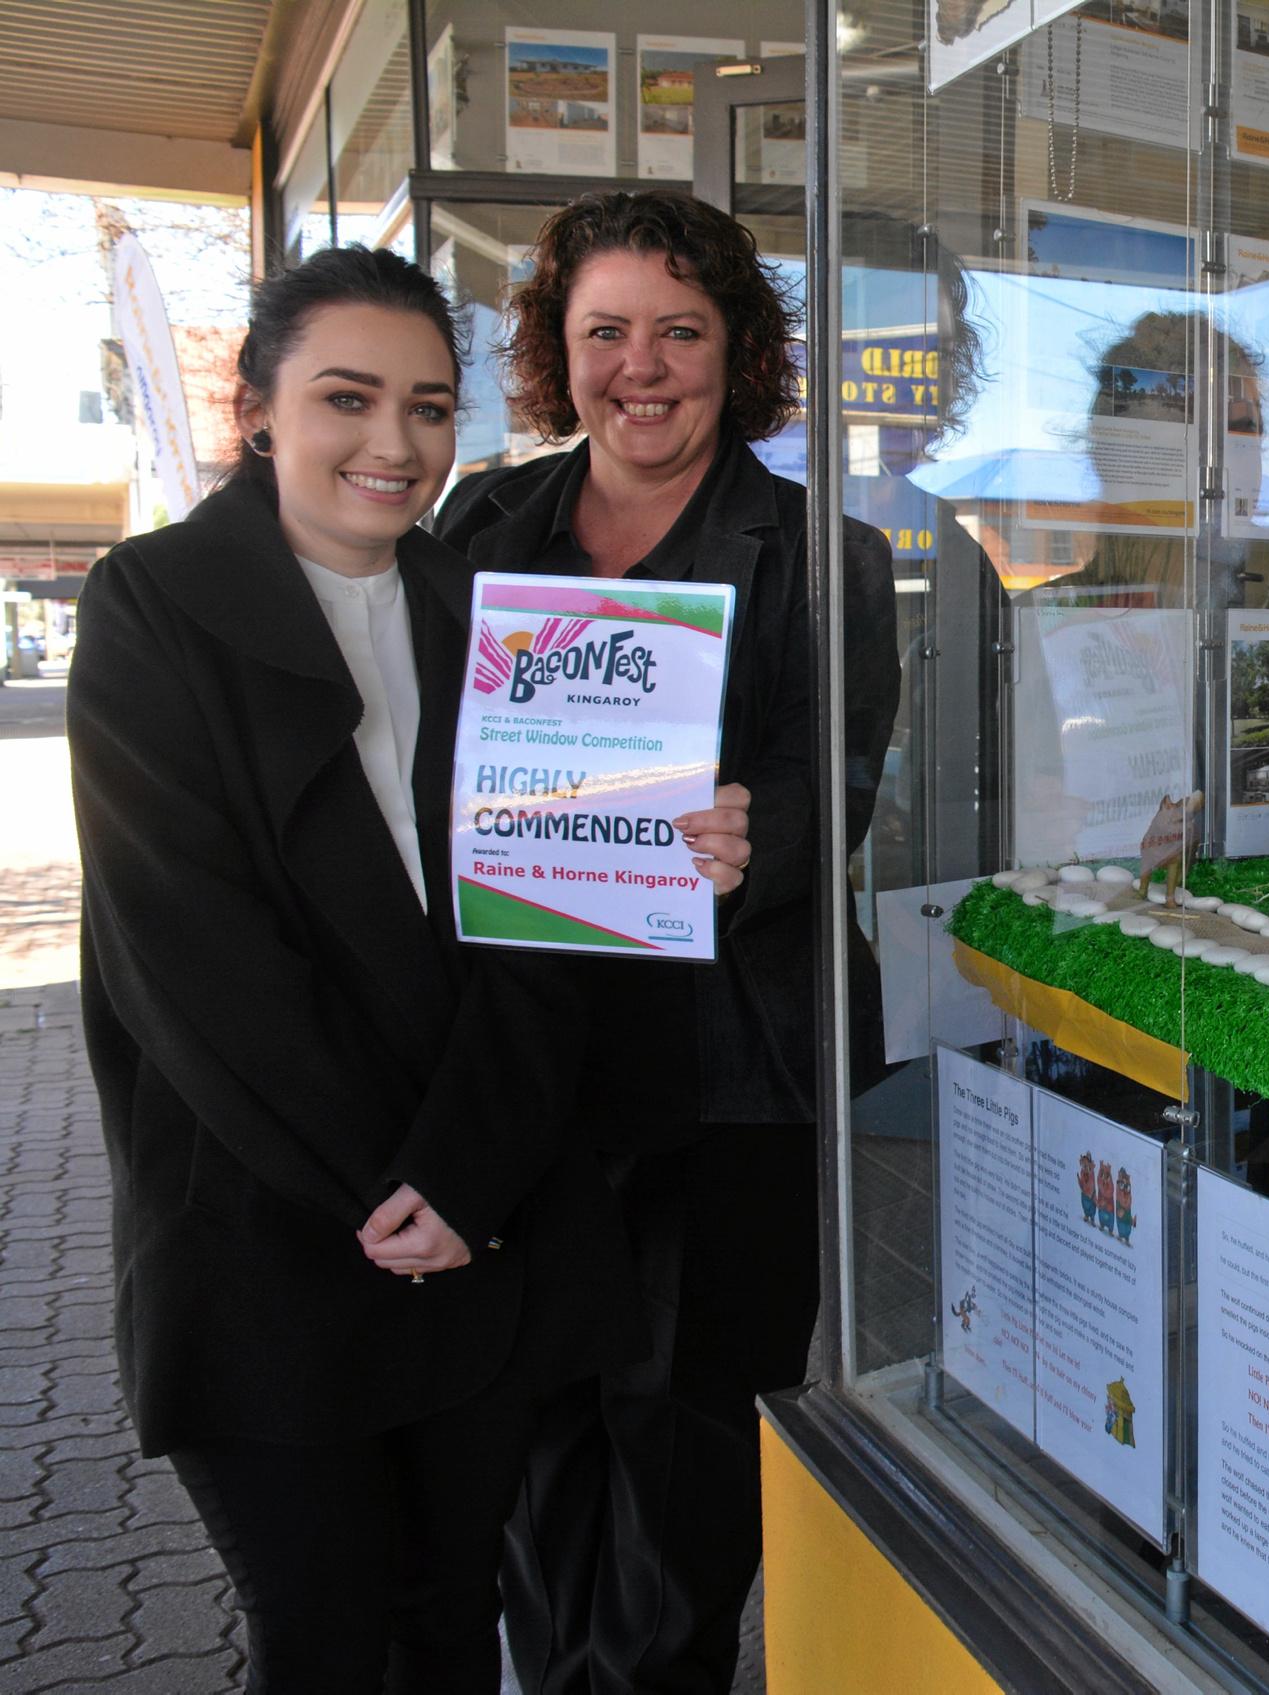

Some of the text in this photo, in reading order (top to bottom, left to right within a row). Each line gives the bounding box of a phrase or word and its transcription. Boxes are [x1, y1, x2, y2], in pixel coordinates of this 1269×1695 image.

[567, 694, 641, 707] KINGAROY
[481, 715, 563, 727] KCCI & BACONFEST
[480, 727, 663, 751] Street Window Competition
[476, 764, 587, 799] HIGHLY
[474, 807, 675, 847] COMMENDED
[473, 861, 700, 891] Raine & Horne Kingaroy
[657, 918, 684, 931] KCCI
[953, 1082, 1018, 1125] The Three Little Pigs
[1248, 1389, 1261, 1406] NO!
[1248, 1413, 1263, 1431] Then
